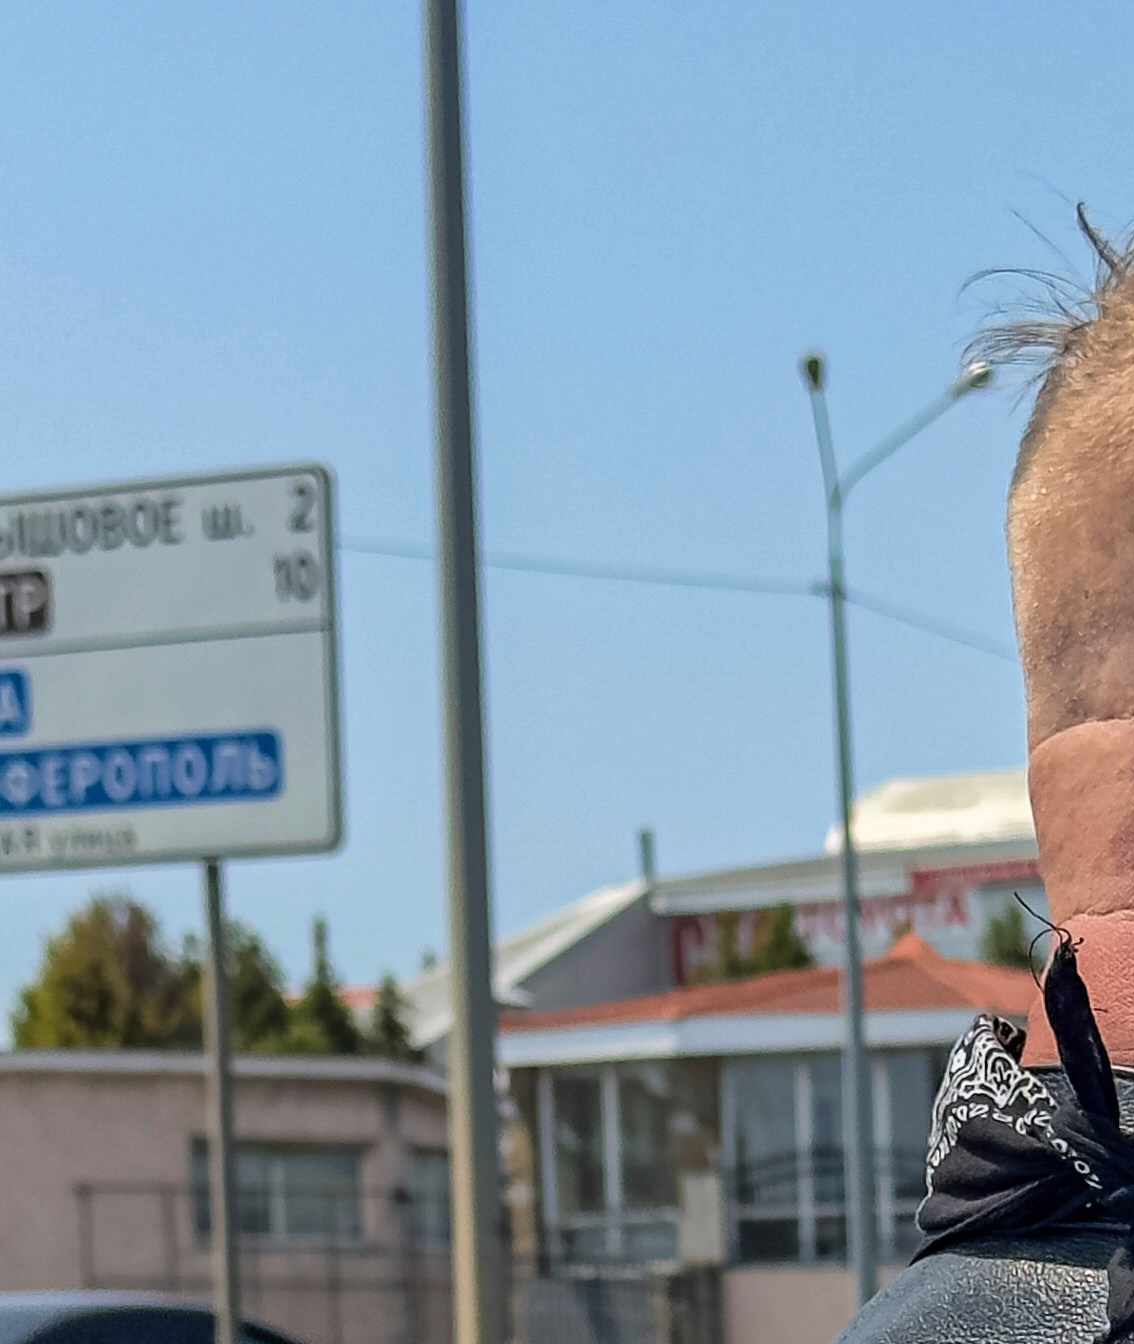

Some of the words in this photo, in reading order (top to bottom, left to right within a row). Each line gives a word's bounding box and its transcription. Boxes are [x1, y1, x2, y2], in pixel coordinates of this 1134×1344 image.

[289, 482, 314, 533] 2
[274, 551, 321, 602] 10
[1, 738, 278, 806] ФЕРОПОЛЬ
